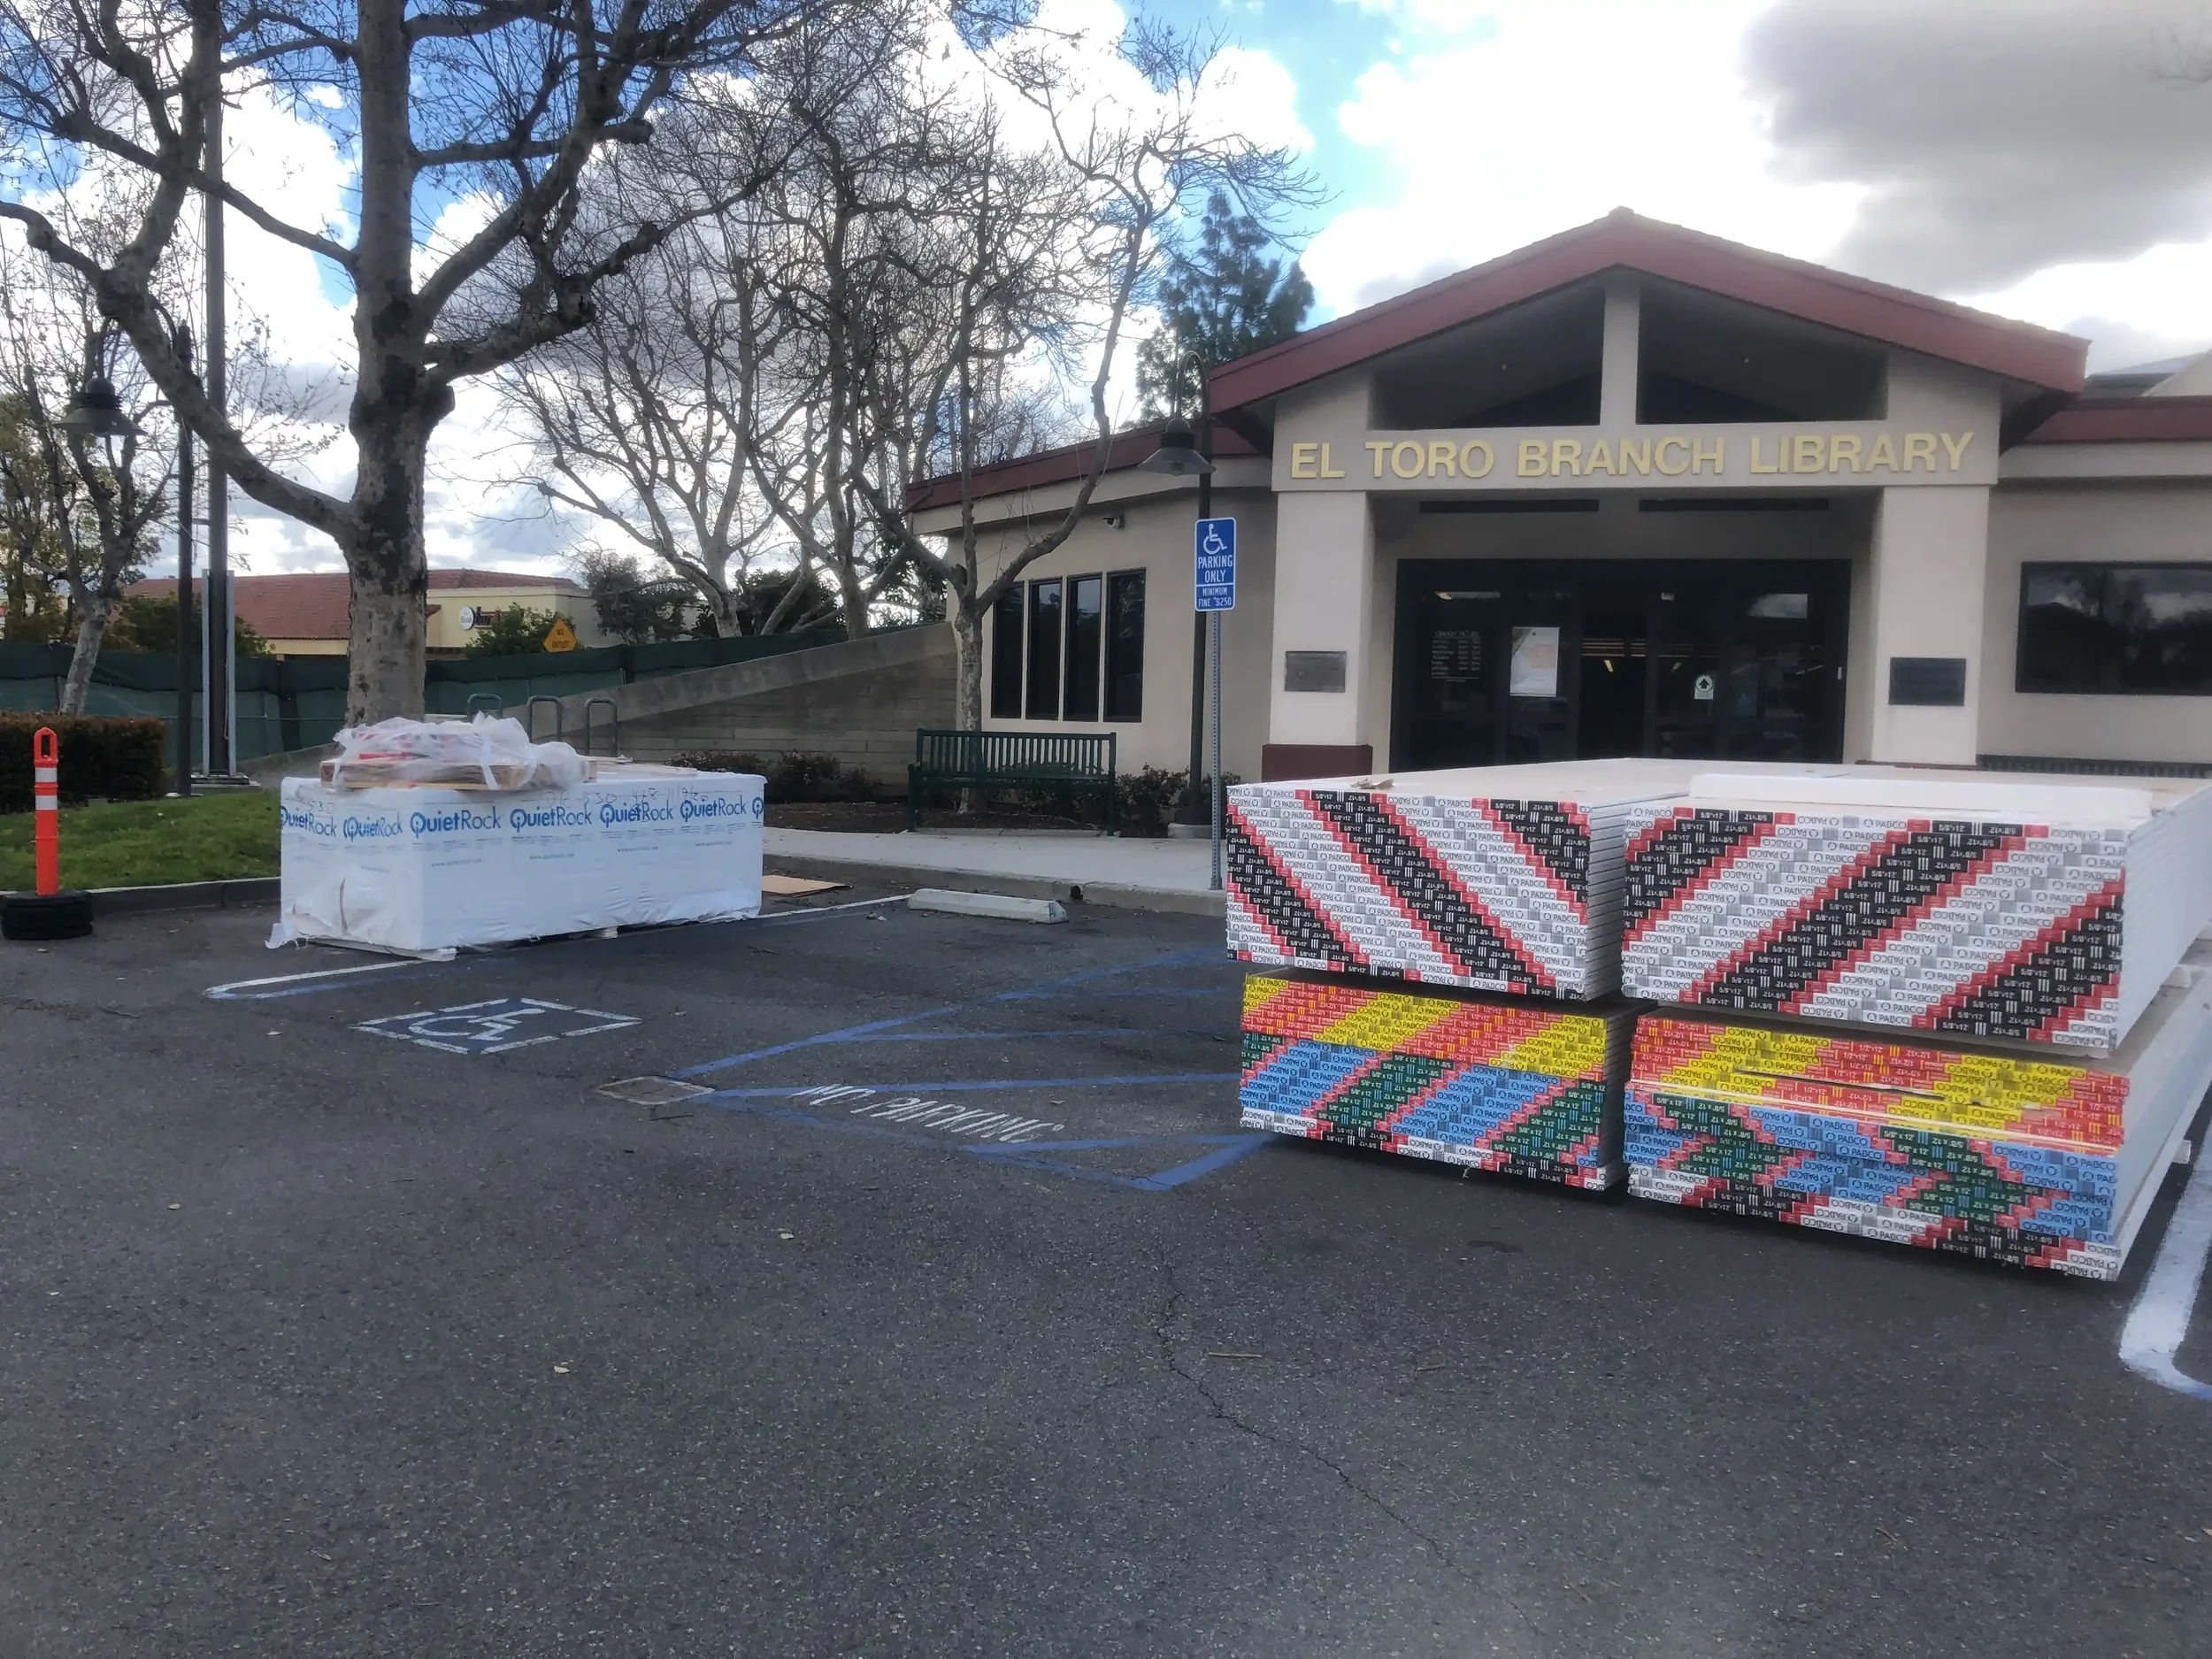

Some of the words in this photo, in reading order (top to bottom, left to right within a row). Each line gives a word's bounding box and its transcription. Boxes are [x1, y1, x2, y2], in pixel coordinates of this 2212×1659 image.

[1291, 442, 1345, 478] EL
[1364, 441, 1494, 478] TORO
[1517, 436, 1724, 477] BRANCH
[1750, 432, 1975, 473] LIBRARY
[1197, 555, 1233, 569] PARKING
[1204, 570, 1226, 583] ONLY
[1202, 587, 1227, 596] MINIMUM
[1198, 598, 1211, 607] FINE
[1215, 597, 1232, 607] $250
[600, 799, 674, 828] QuietRock
[680, 795, 747, 823] QuietRock
[510, 803, 593, 833] QuietRock
[1292, 810, 1312, 819] PABCO
[410, 806, 502, 839] QuietRock
[1469, 820, 1491, 830] PABCO
[1876, 819, 1906, 829] PABCO
[1310, 831, 1332, 841] PABCO
[1489, 844, 1513, 853] PABCO
[1839, 842, 1869, 852] PABCO
[1510, 866, 1534, 877] PABCO
[1347, 873, 1369, 883] PABCO
[1784, 887, 1813, 895] PABCO
[2067, 882, 2101, 892] PABCO
[1366, 896, 1389, 906] PABCO
[1542, 902, 1568, 911] PABCO
[1757, 909, 1786, 918] PABCO
[1387, 918, 1409, 928] PABCO
[1554, 914, 1578, 924] PABCO
[1730, 930, 1757, 939] PABCO
[2002, 930, 2036, 939] PABCO
[1409, 940, 1431, 950] PABCO
[1701, 950, 1730, 959] PABCO
[1970, 951, 2003, 961] PABCO
[1306, 960, 1326, 969] PABCO
[1676, 971, 1703, 979] PABCO
[1938, 973, 1970, 982] PABCO
[1893, 1004, 1924, 1014] PABCO
[1801, 1037, 1829, 1047] PABCO
[1352, 1048, 1374, 1057] PABCO
[1775, 1062, 1804, 1071] PABCO
[1552, 1068, 1577, 1077] PABCO
[1745, 1077, 1772, 1088] PABCO
[1520, 1083, 1545, 1094] PABCO
[1289, 1098, 1310, 1107] PABCO
[2020, 1093, 2054, 1104] PABCO
[1496, 1101, 1520, 1110] PABCO
[1824, 1120, 1854, 1132] PABCO
[1653, 1138, 1680, 1148] PABCO
[1468, 1149, 1492, 1160] PABCO
[1852, 1148, 1882, 1159] PABCO
[2081, 1159, 2116, 1171] PABCO
[1679, 1175, 1706, 1185] PABCO
[1864, 1180, 1894, 1194] PABCO
[1654, 1192, 1679, 1202] PABCO
[1879, 1232, 1909, 1241] PABCO
